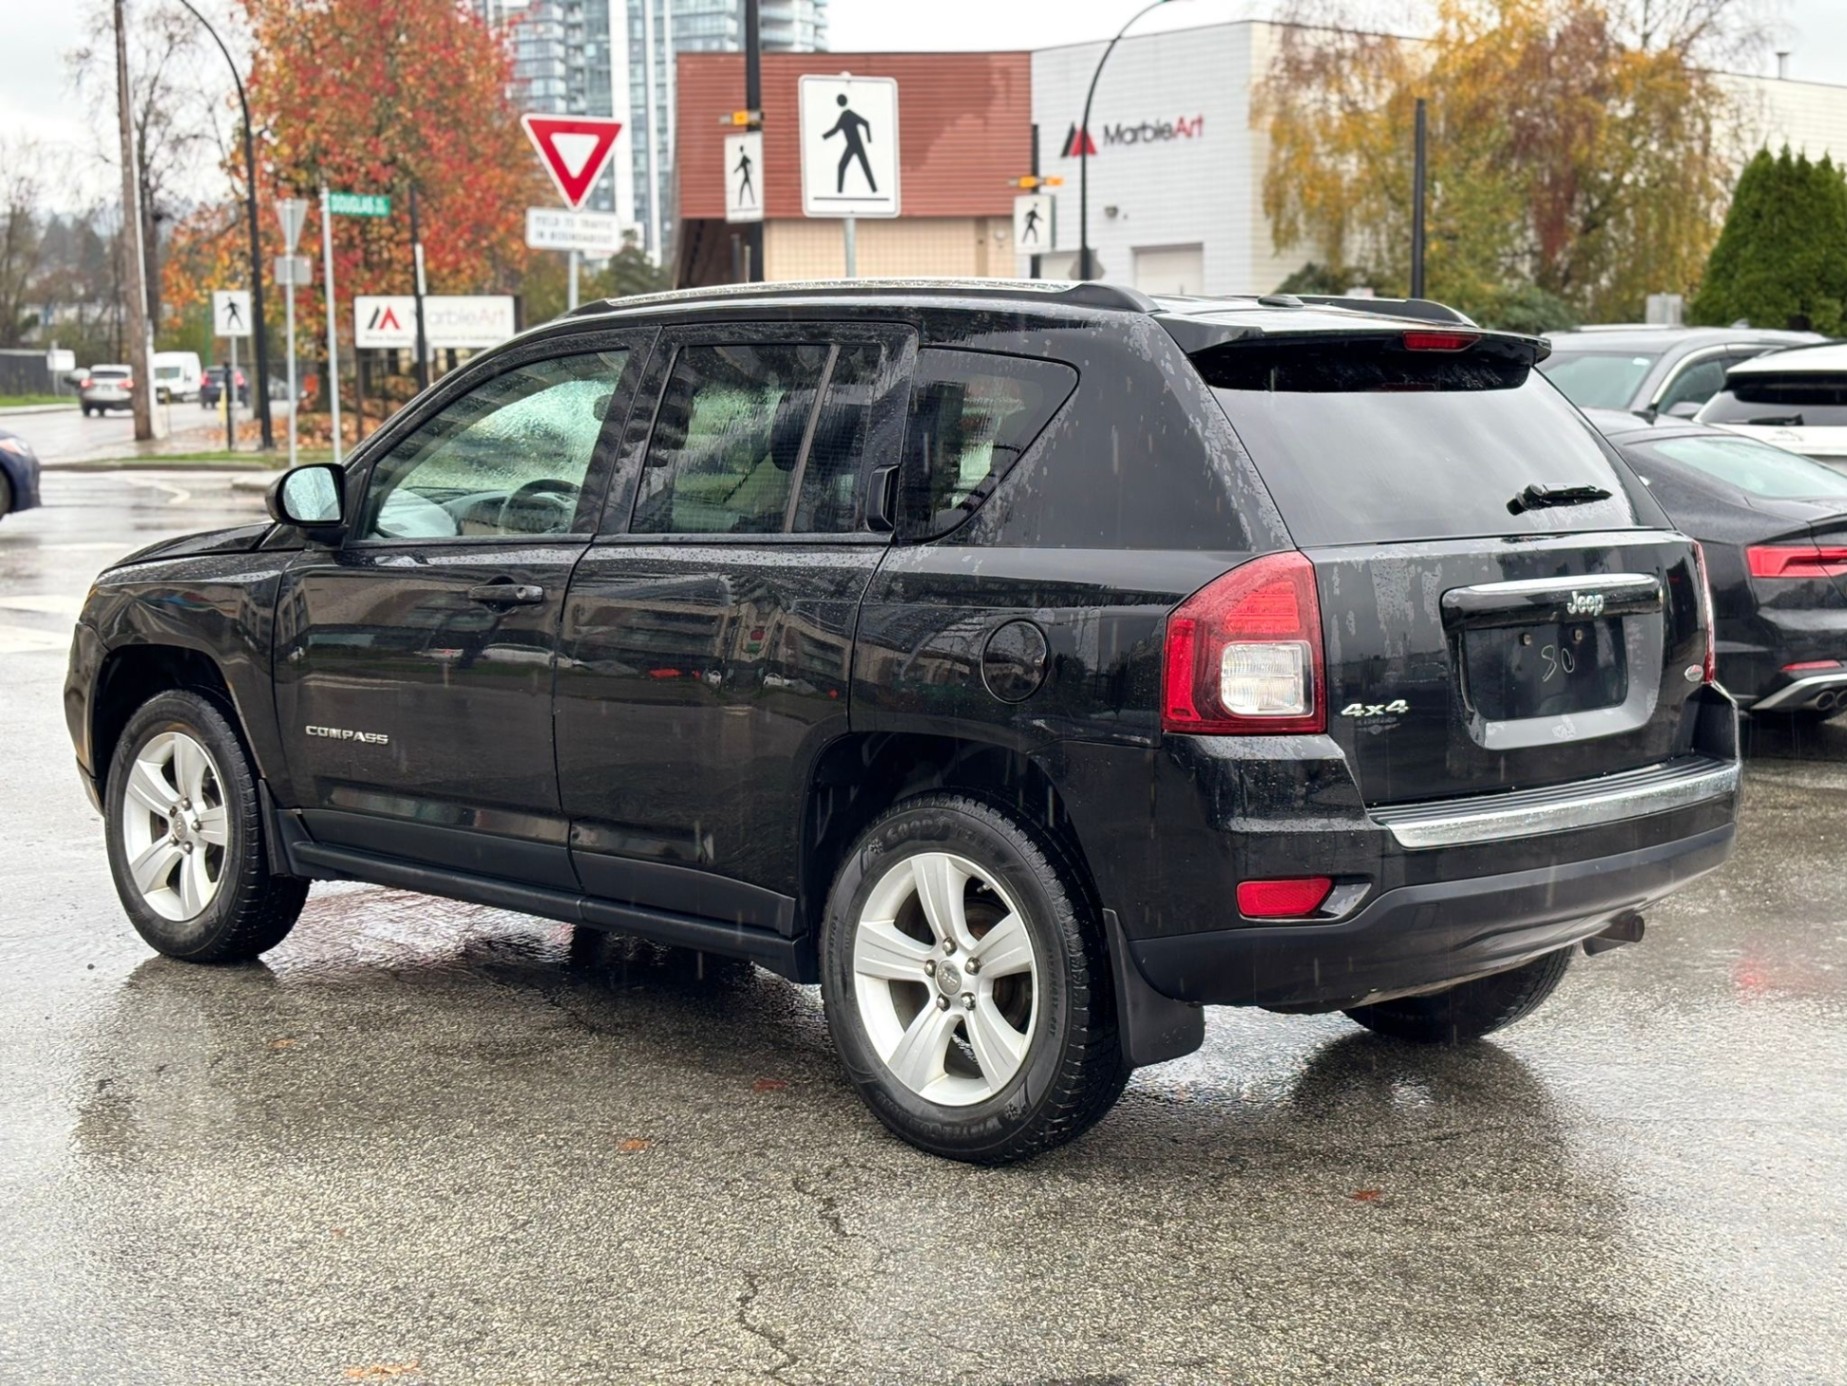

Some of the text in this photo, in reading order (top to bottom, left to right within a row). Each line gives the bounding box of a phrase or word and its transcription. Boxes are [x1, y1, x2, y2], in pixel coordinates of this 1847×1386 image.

[1103, 114, 1204, 146] MarbleArt
[1566, 590, 1605, 617] Jeep
[1340, 699, 1409, 717] 4x4
[305, 725, 389, 745] COMPASS
